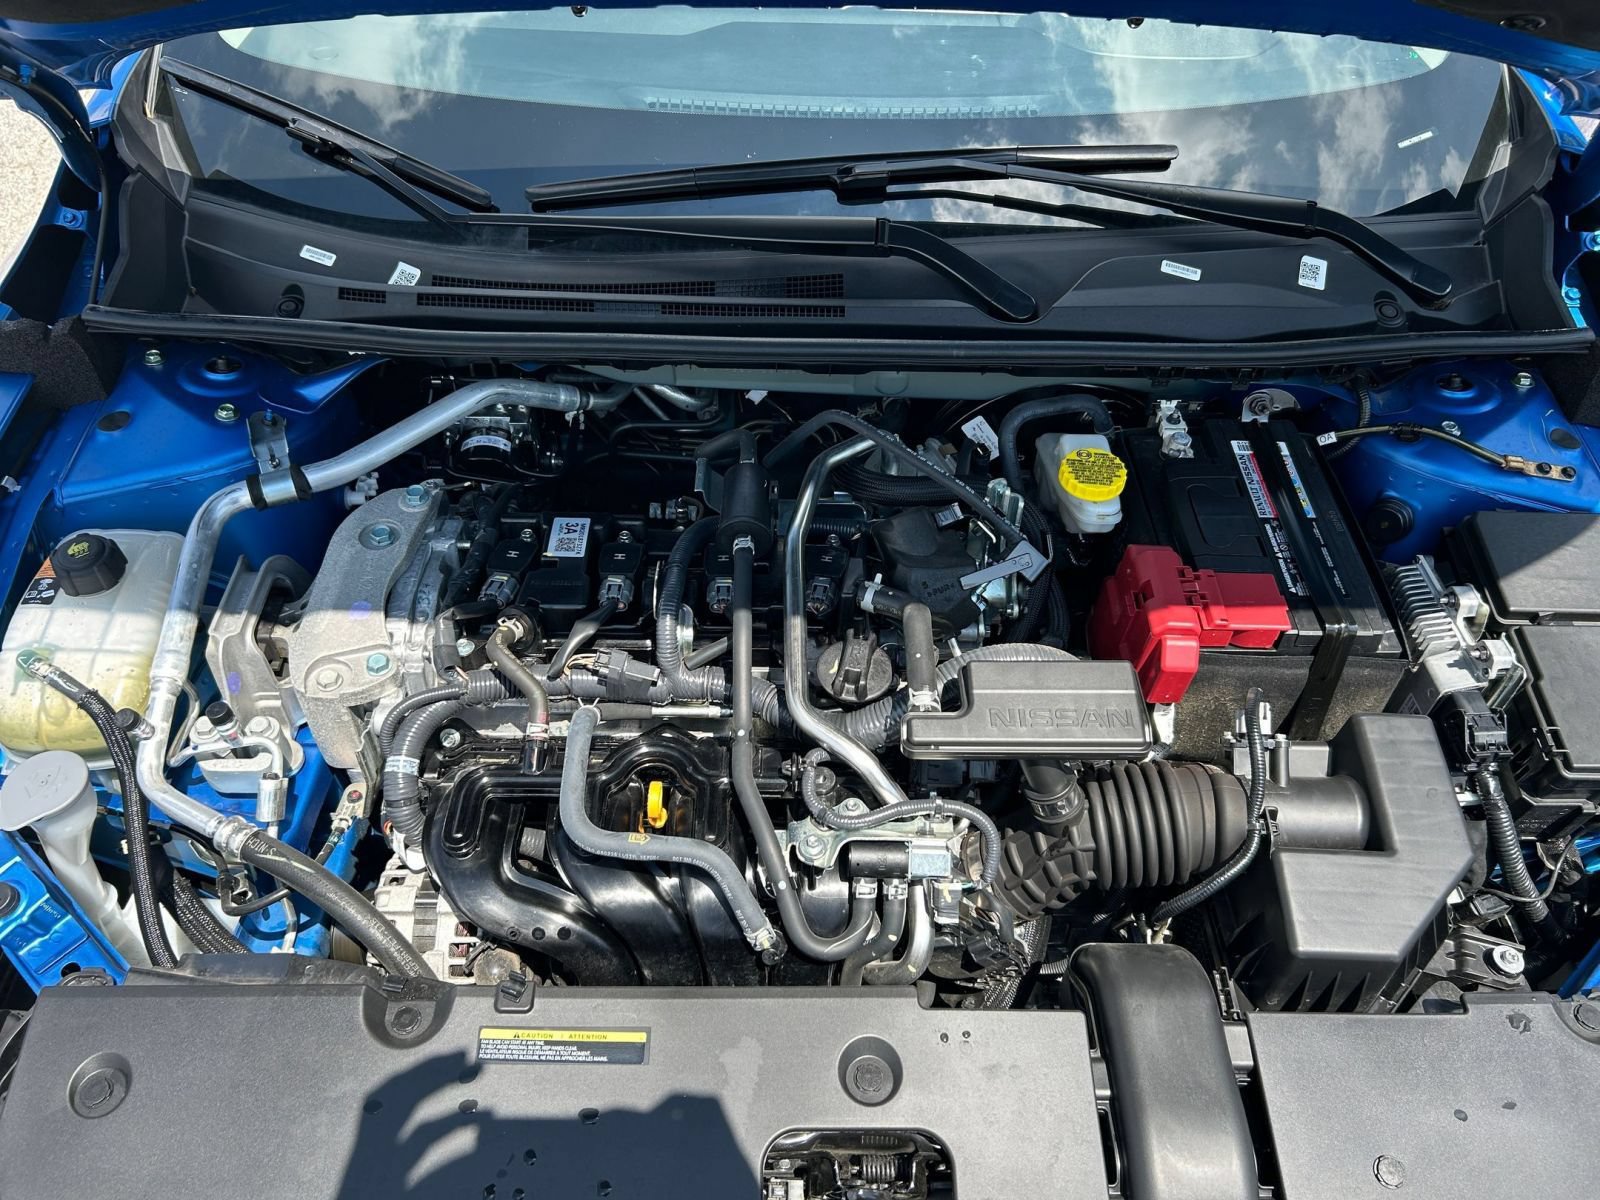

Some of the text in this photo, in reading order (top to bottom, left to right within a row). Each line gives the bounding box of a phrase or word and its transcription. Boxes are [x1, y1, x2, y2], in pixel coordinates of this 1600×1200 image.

[1240, 454, 1254, 486] NISSAN
[1249, 486, 1267, 516] RENAULT
[564, 522, 579, 535] 3A
[988, 708, 1136, 729] NISSAN
